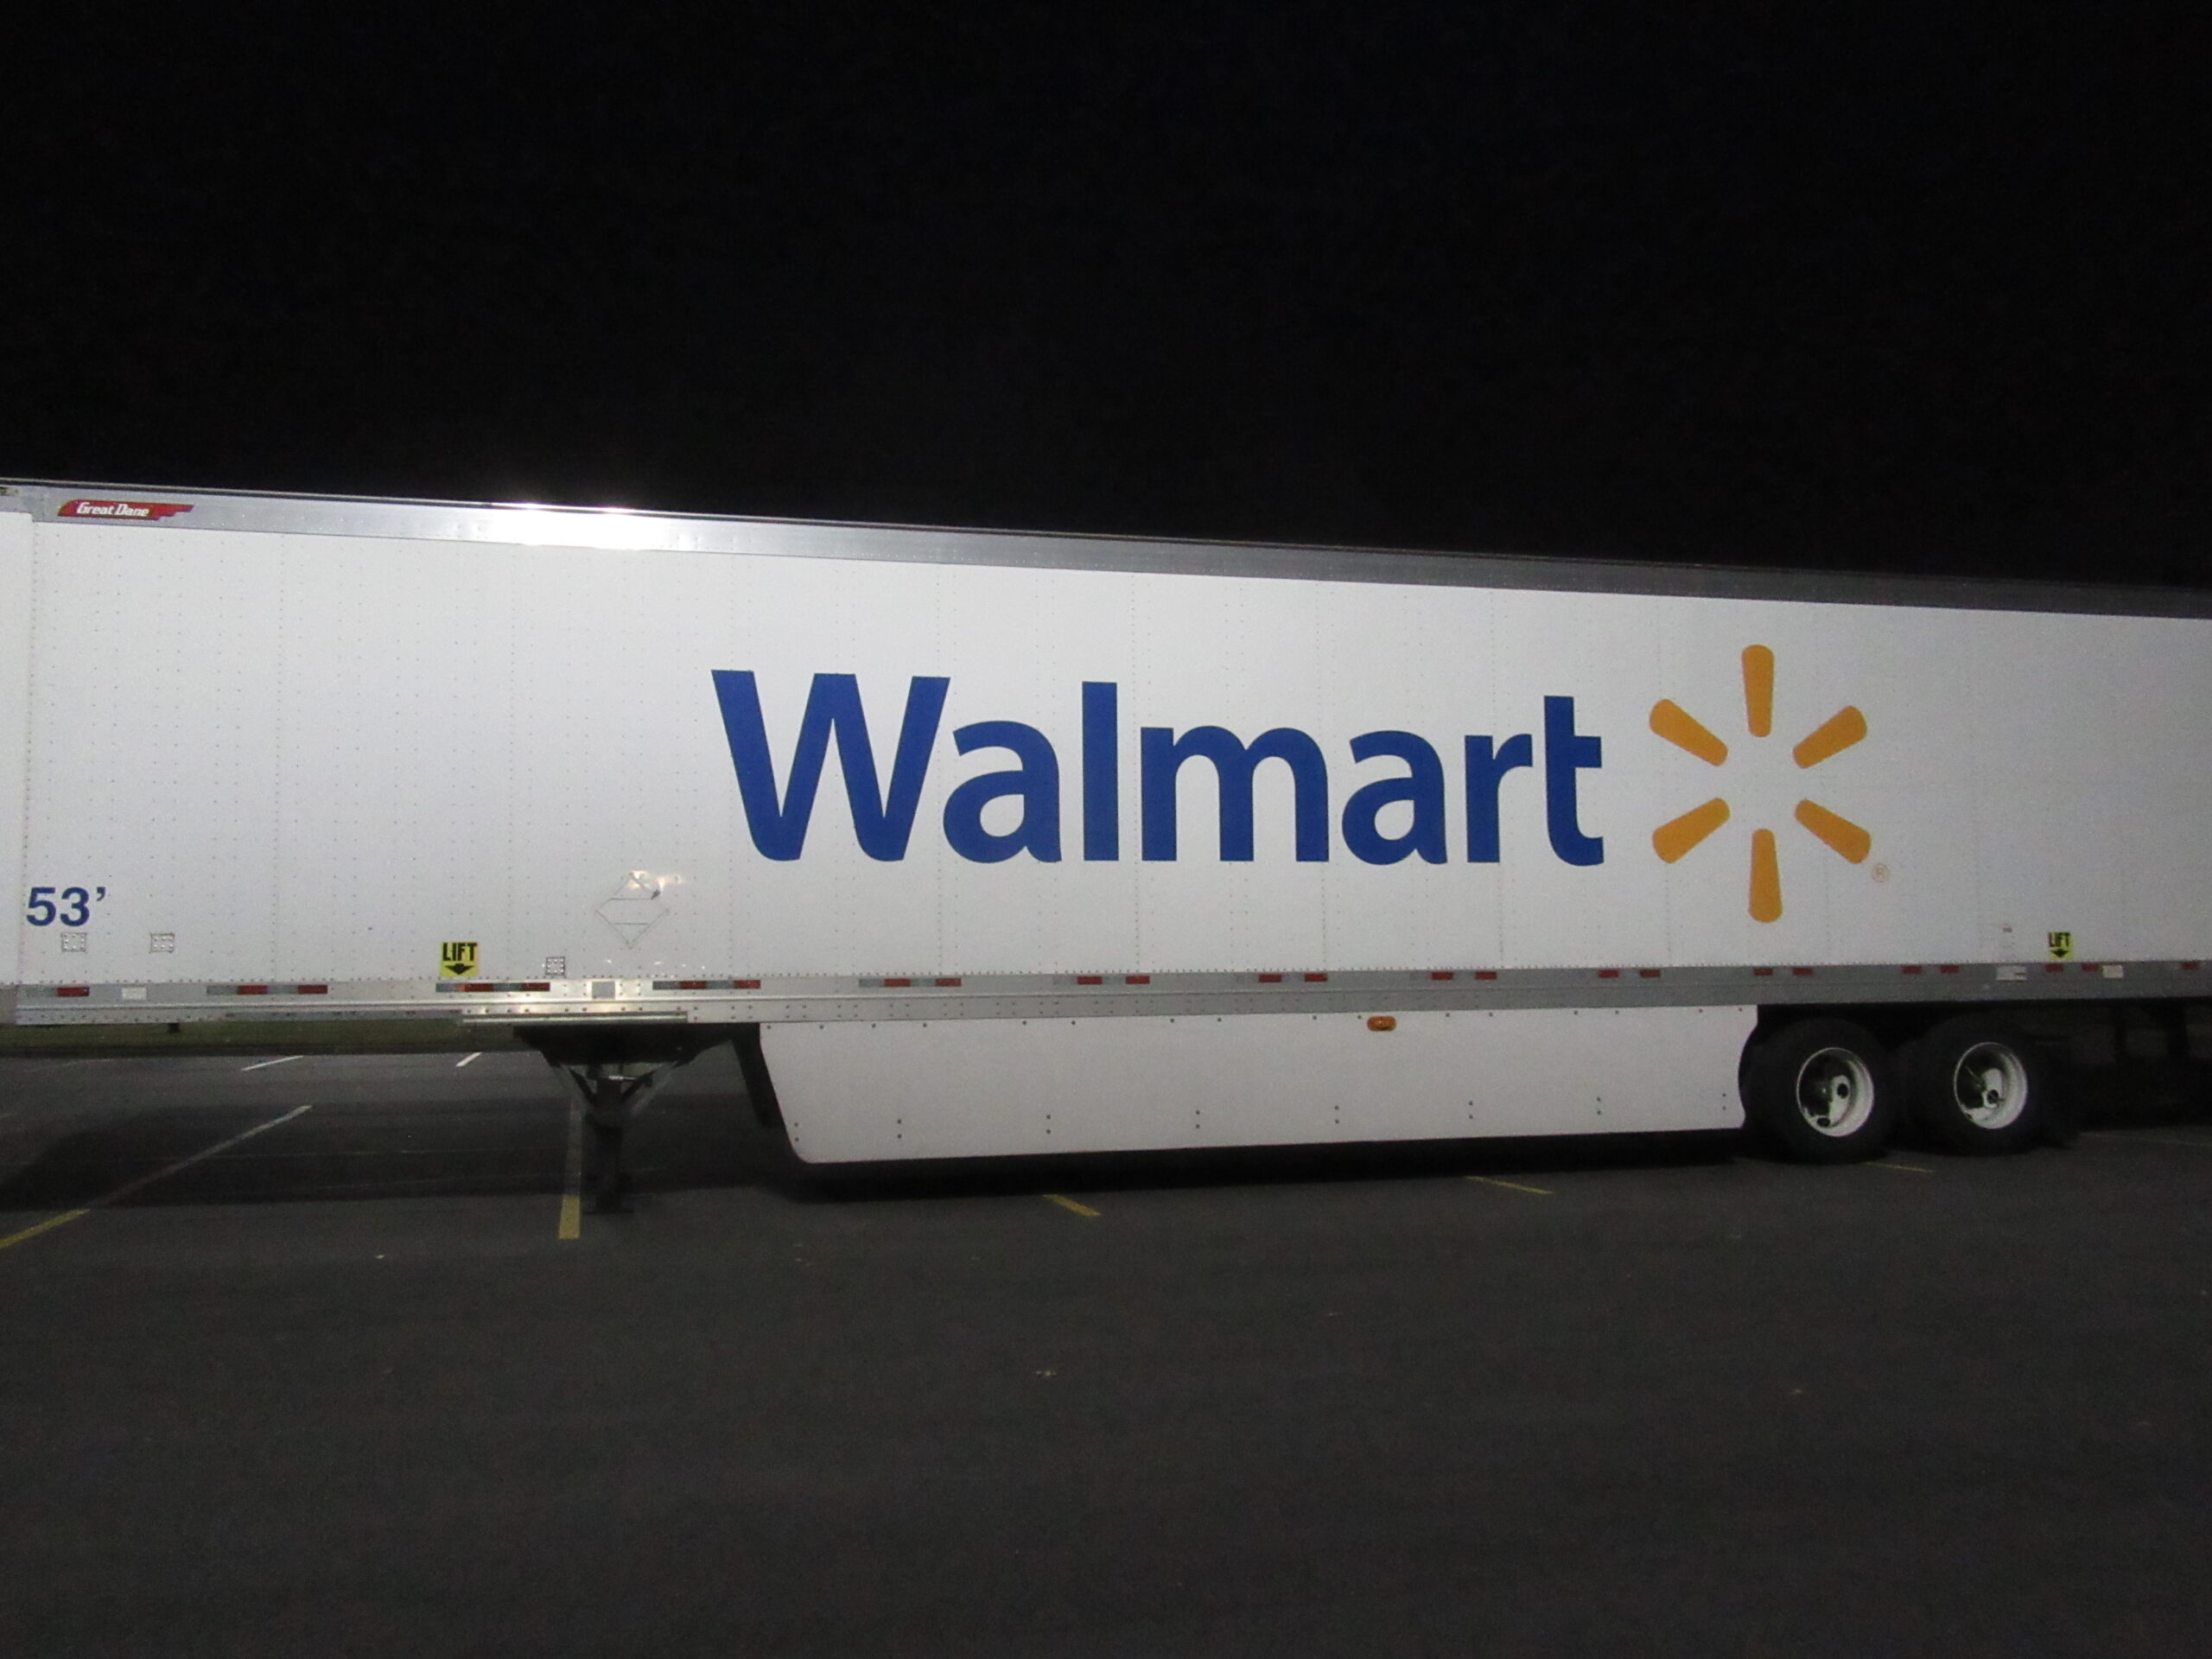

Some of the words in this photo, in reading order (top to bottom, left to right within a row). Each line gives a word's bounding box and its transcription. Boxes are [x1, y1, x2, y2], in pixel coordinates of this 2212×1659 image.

[76, 501, 113, 516] Great
[115, 503, 150, 517] Dane
[710, 670, 1605, 867] Walmart
[2048, 931, 2071, 948] LIFT
[442, 941, 478, 962] LIFT
